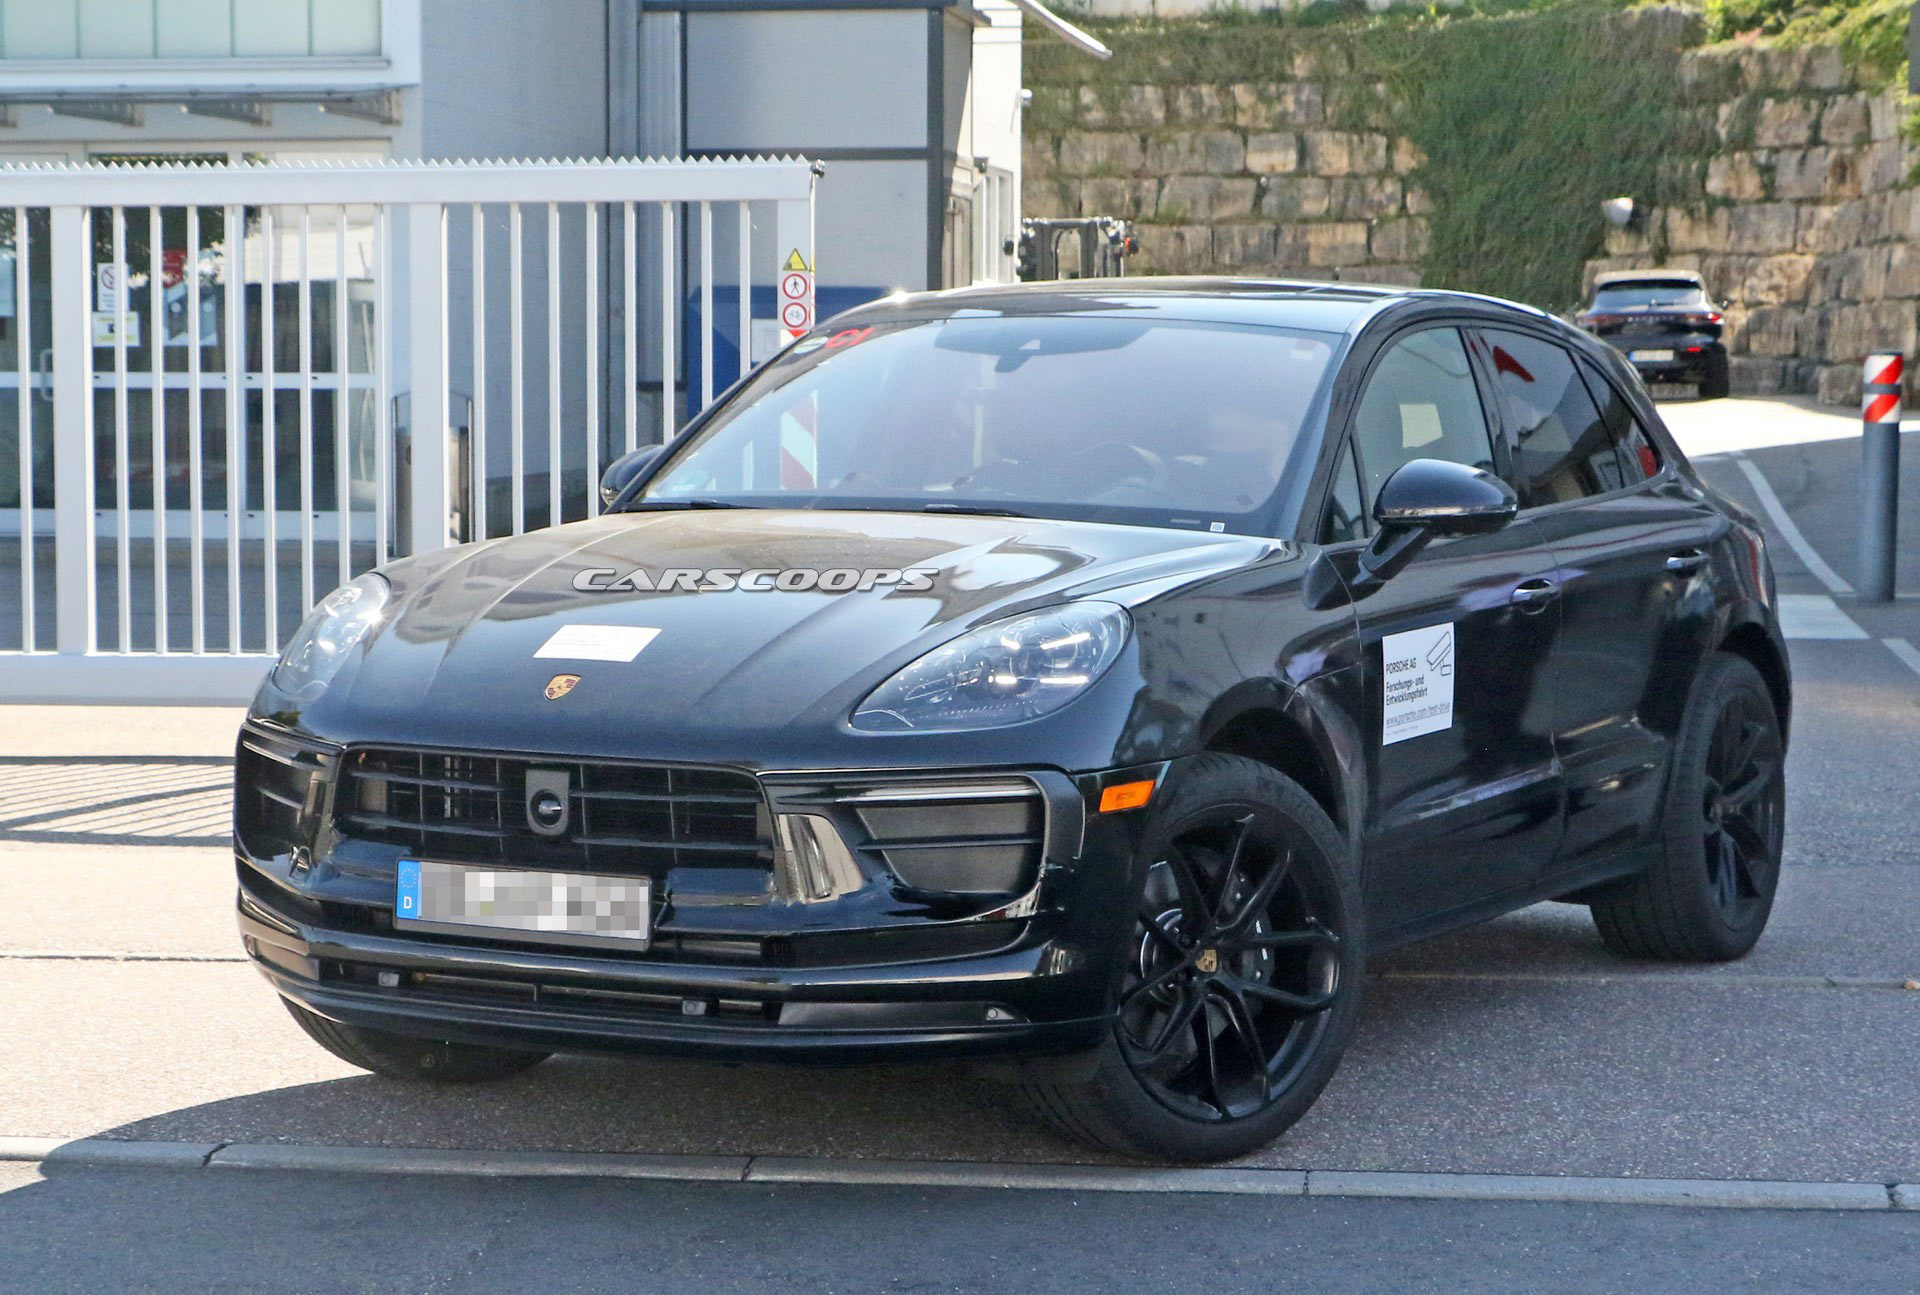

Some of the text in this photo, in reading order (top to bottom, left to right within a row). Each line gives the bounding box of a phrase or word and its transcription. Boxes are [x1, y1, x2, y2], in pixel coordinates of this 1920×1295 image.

[1386, 657, 1417, 674] PORSCHE AG
[1386, 674, 1425, 693] Forschungs- und
[1386, 688, 1428, 705] Entwicklungsfahrt
[404, 896, 412, 909] D
